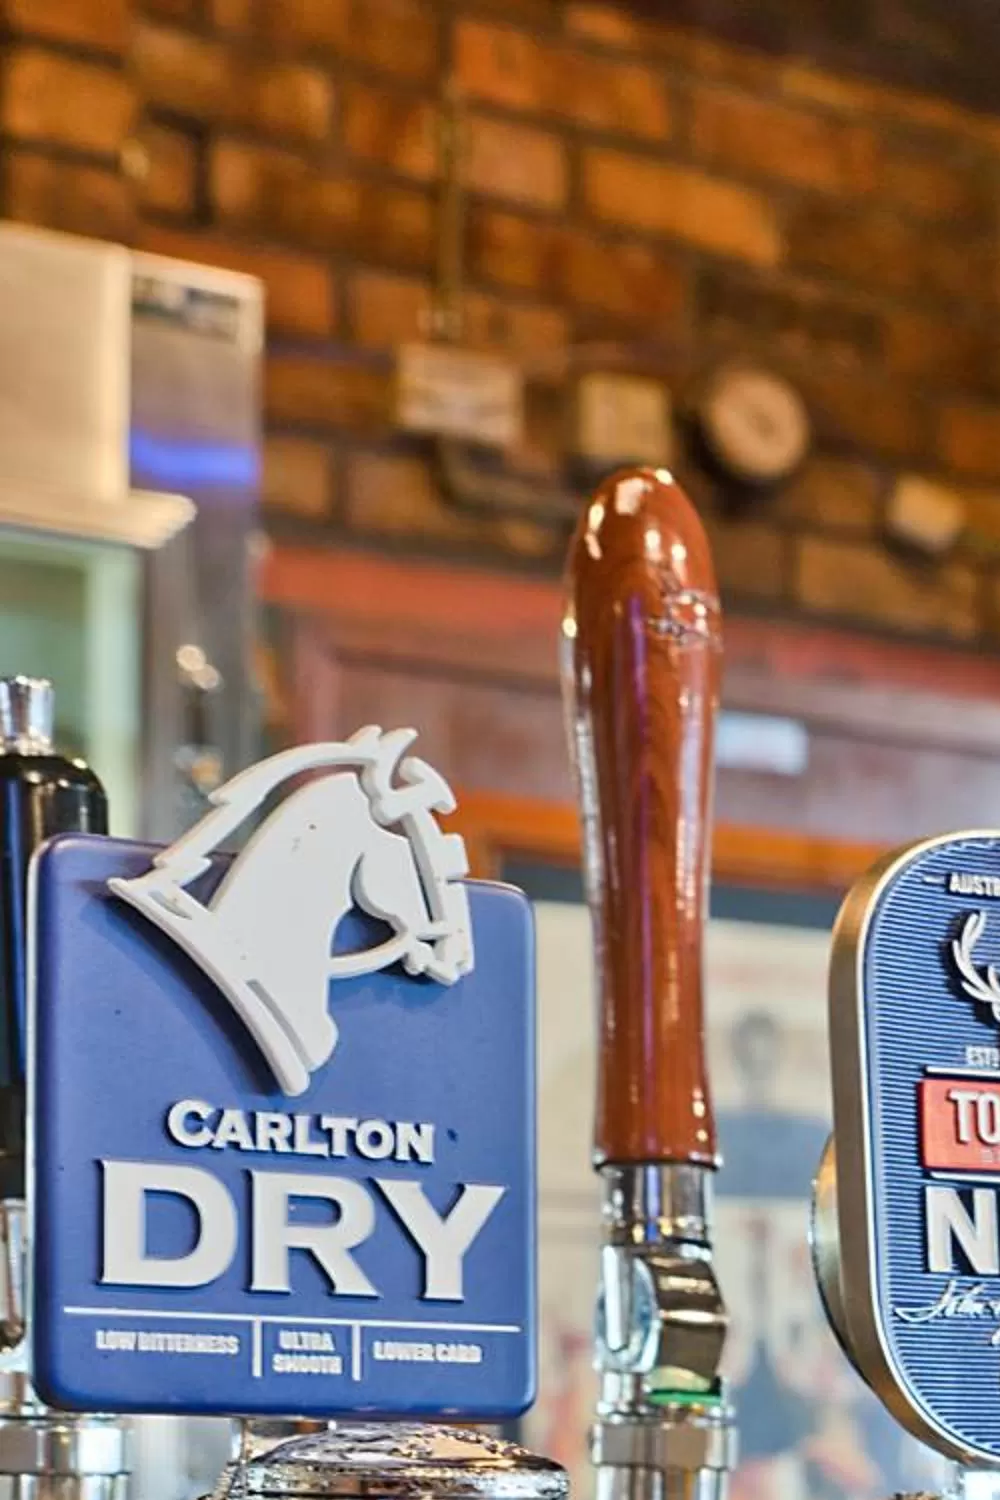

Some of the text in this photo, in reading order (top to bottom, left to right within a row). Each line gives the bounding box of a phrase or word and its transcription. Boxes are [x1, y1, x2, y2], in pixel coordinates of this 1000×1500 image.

[167, 1099, 436, 1164] CARLTON
[97, 1160, 507, 1303] DRY
[95, 1329, 241, 1356] LOW BITTERNESS
[278, 1330, 336, 1352] ULTRA
[372, 1340, 435, 1361] LOWER
